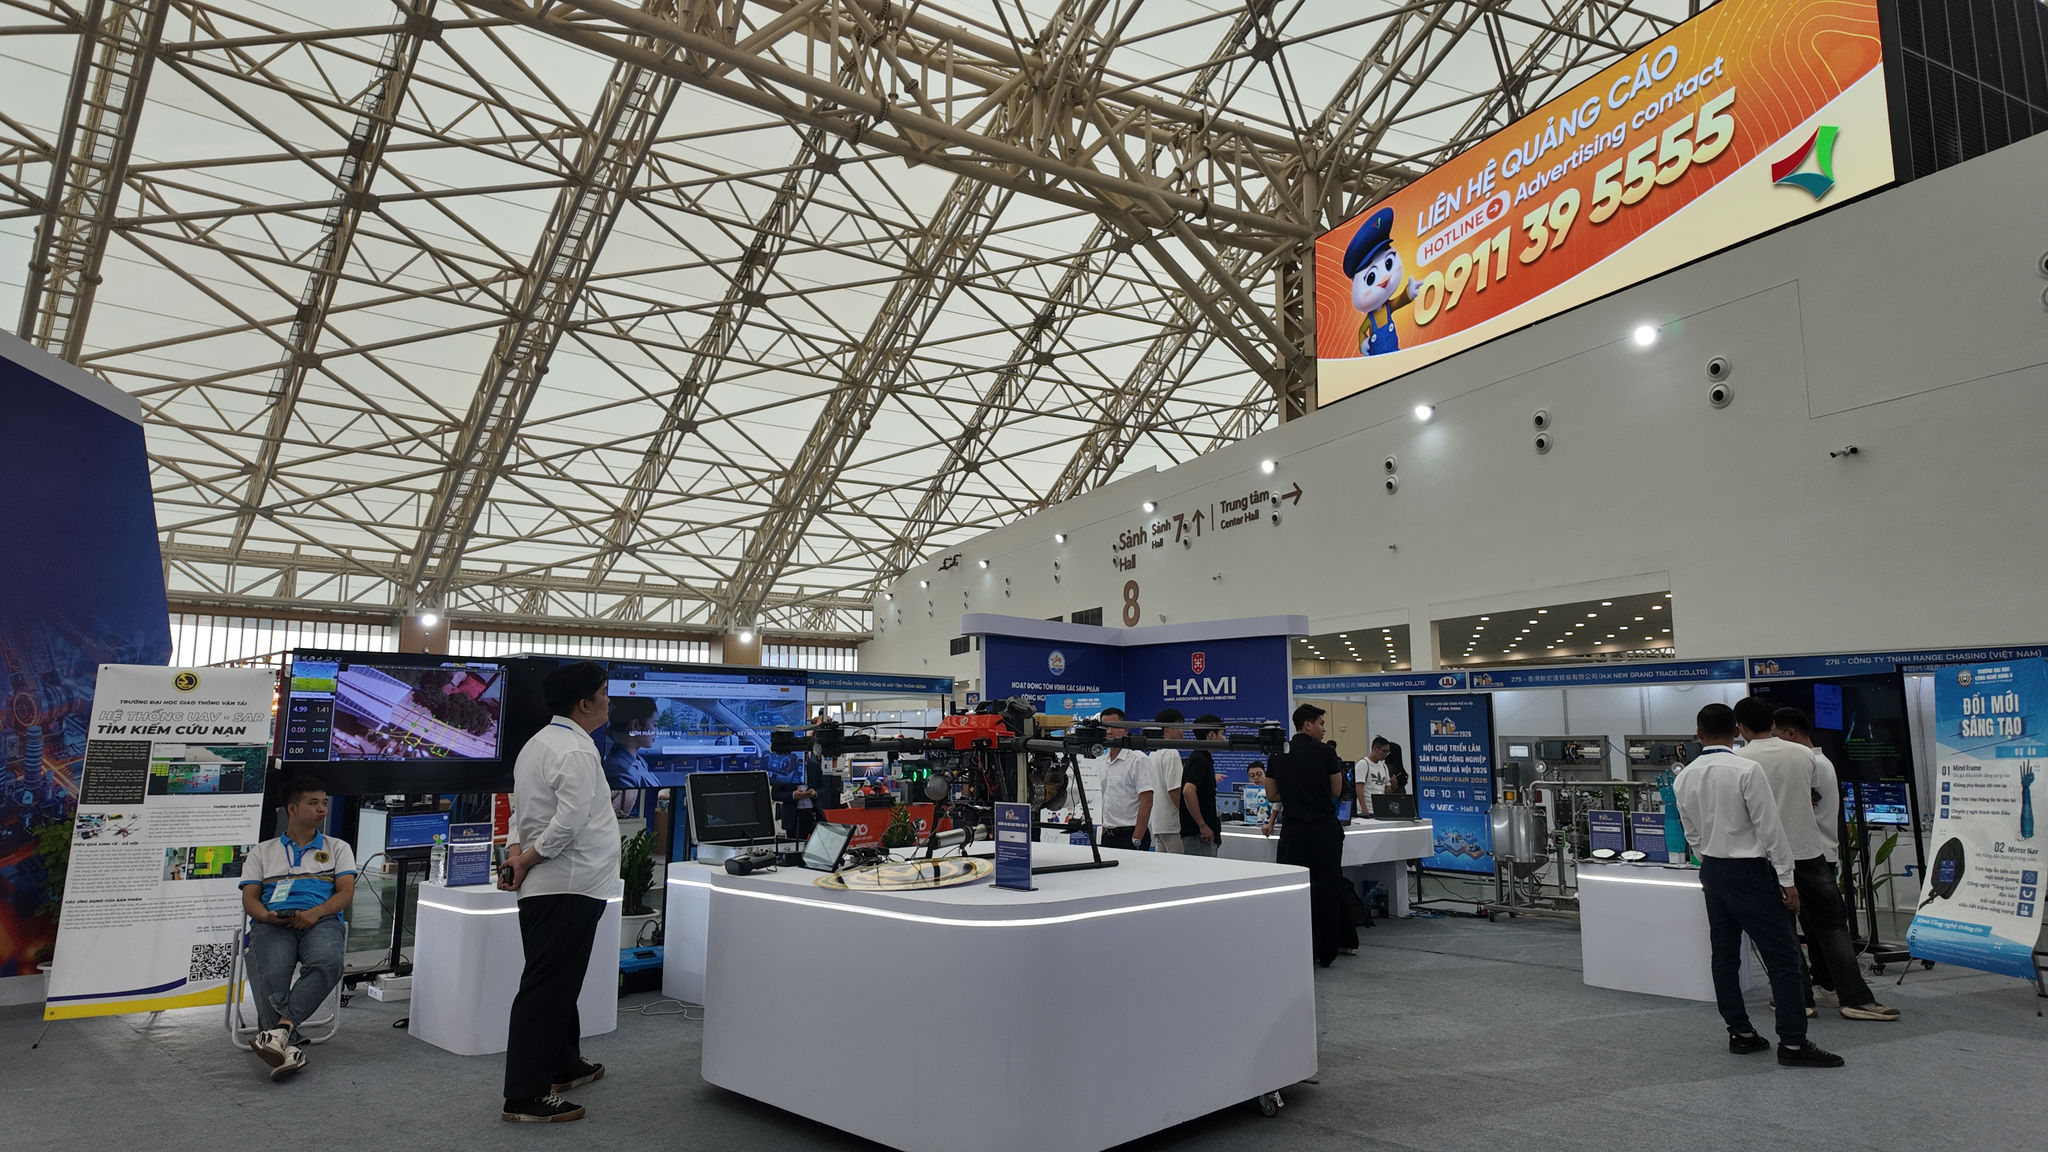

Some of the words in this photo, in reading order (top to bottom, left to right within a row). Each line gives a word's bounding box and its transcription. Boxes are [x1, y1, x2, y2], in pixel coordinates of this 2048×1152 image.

[1416, 186, 1463, 238] LIÊN
[1466, 158, 1498, 200] HỆ
[1501, 96, 1602, 179] QUẢNG
[1607, 45, 1678, 109] CÁO
[1424, 209, 1484, 261] HOTLINE
[1513, 121, 1626, 207] Advertising
[1631, 55, 1725, 130] contact
[1413, 225, 1511, 326] 0911
[1518, 187, 1581, 264] 39
[1588, 86, 1736, 224] 5555
[1220, 498, 1248, 514] Trung
[1249, 489, 1270, 505] tâm
[1151, 519, 1171, 536] Sảnh
[1173, 513, 1185, 543] 7
[1220, 516, 1244, 530] Center
[1244, 509, 1260, 523] Hall
[1119, 526, 1148, 551] Sảnh
[1151, 538, 1164, 550] Hall
[1119, 554, 1136, 572] Hall
[1123, 580, 1141, 627] 8
[1824, 658, 1839, 666] 276
[1847, 655, 1872, 665] CÔNG
[1874, 656, 1885, 665] TY
[1887, 655, 1911, 663] TNHH
[1913, 654, 1944, 662] RANGE
[1946, 652, 1987, 661] CHASING
[1990, 649, 2013, 661] (VIỆT
[2016, 648, 2042, 658] NAM)
[1381, 680, 1404, 688] VIETNAM
[1613, 671, 1629, 679] NEW
[1630, 671, 1654, 679] GRAND
[1163, 676, 1237, 696] HAMI
[293, 705, 308, 713] 4.99
[1991, 690, 2019, 714] MỚI
[99, 709, 123, 723] HỆ
[127, 708, 184, 722] THỐNG
[186, 712, 221, 722] UAV
[233, 712, 265, 723] SAR
[97, 722, 127, 735] TÌM
[130, 722, 171, 735] KIẾM
[174, 723, 208, 735] CỨU
[211, 726, 247, 738] NẠN
[1962, 714, 1994, 737] SÁNG
[1997, 716, 2022, 739] TẠO
[1423, 743, 1434, 753] HỘI
[1435, 744, 1448, 753] CHỢ
[1449, 742, 1467, 752] TRIỂN
[1419, 754, 1430, 762] SẢN
[1431, 753, 1447, 763] PHẨM
[1448, 754, 1464, 763] CÔNG
[1465, 755, 1487, 764] NGHIỆP
[1419, 764, 1437, 773] THÀNH
[1438, 764, 1451, 773] PHỐ
[1452, 765, 1460, 773] HÀ
[1461, 766, 1472, 774] NỘI
[1942, 765, 1950, 776] 01
[1423, 789, 1435, 797] 09
[1441, 790, 1451, 798] 10
[1457, 790, 1466, 798] 11
[1994, 842, 2005, 853] 02
[2008, 846, 2026, 855] Mirror
[2027, 847, 2039, 856] Nav
